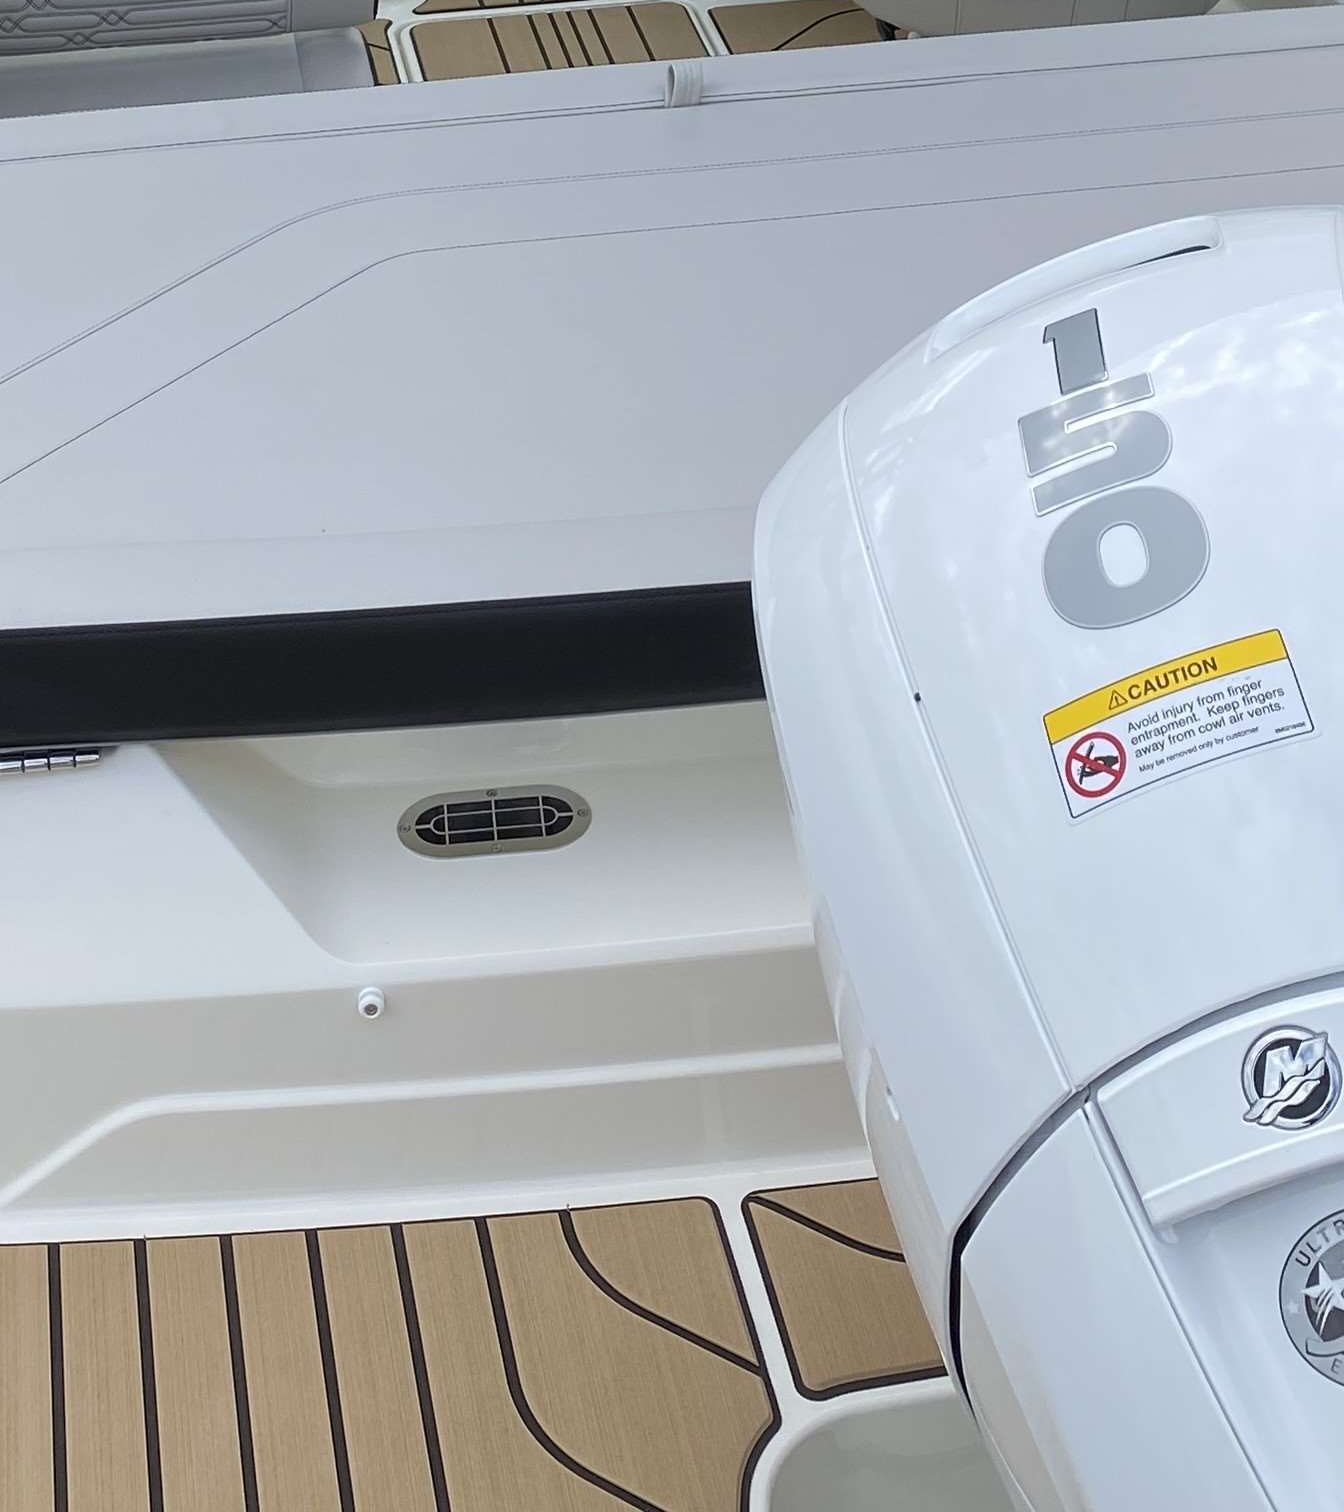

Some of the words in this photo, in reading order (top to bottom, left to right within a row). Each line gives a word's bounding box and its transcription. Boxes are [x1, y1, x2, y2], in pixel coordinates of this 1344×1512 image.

[1017, 307, 1211, 631] 150
[1127, 656, 1219, 700] CAUTION
[1127, 713, 1160, 733] Avoid
[1162, 701, 1194, 721] injury
[1197, 691, 1225, 706] from
[1227, 679, 1263, 697] finger
[1130, 713, 1200, 746] entrapment.
[1207, 700, 1240, 717] Keep
[1242, 687, 1285, 704] fingers
[1135, 740, 1165, 758] away
[1168, 729, 1196, 745] from
[1198, 716, 1226, 735] cowl
[1229, 709, 1245, 725] air
[1247, 702, 1285, 719] vents.
[1138, 762, 1154, 772] May
[1166, 745, 1198, 762] removed
[1198, 742, 1214, 752] only
[1225, 726, 1259, 742] customer
